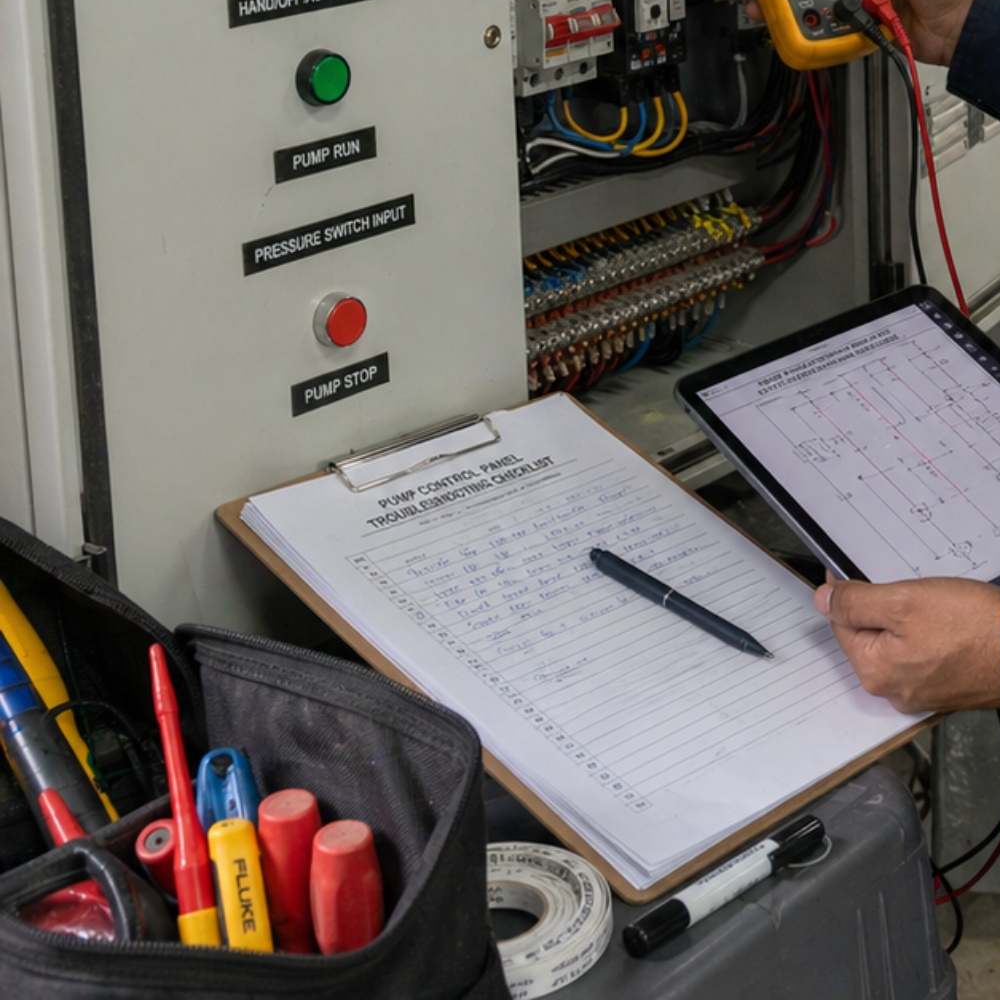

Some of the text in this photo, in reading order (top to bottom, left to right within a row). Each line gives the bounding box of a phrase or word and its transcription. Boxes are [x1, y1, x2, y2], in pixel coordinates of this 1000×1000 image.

[292, 139, 360, 170] PUMP RUN
[254, 204, 407, 264] PRESSURE SWITCH INPUT
[304, 366, 378, 404] PUMP STOP
[233, 857, 257, 934] FLUKE
